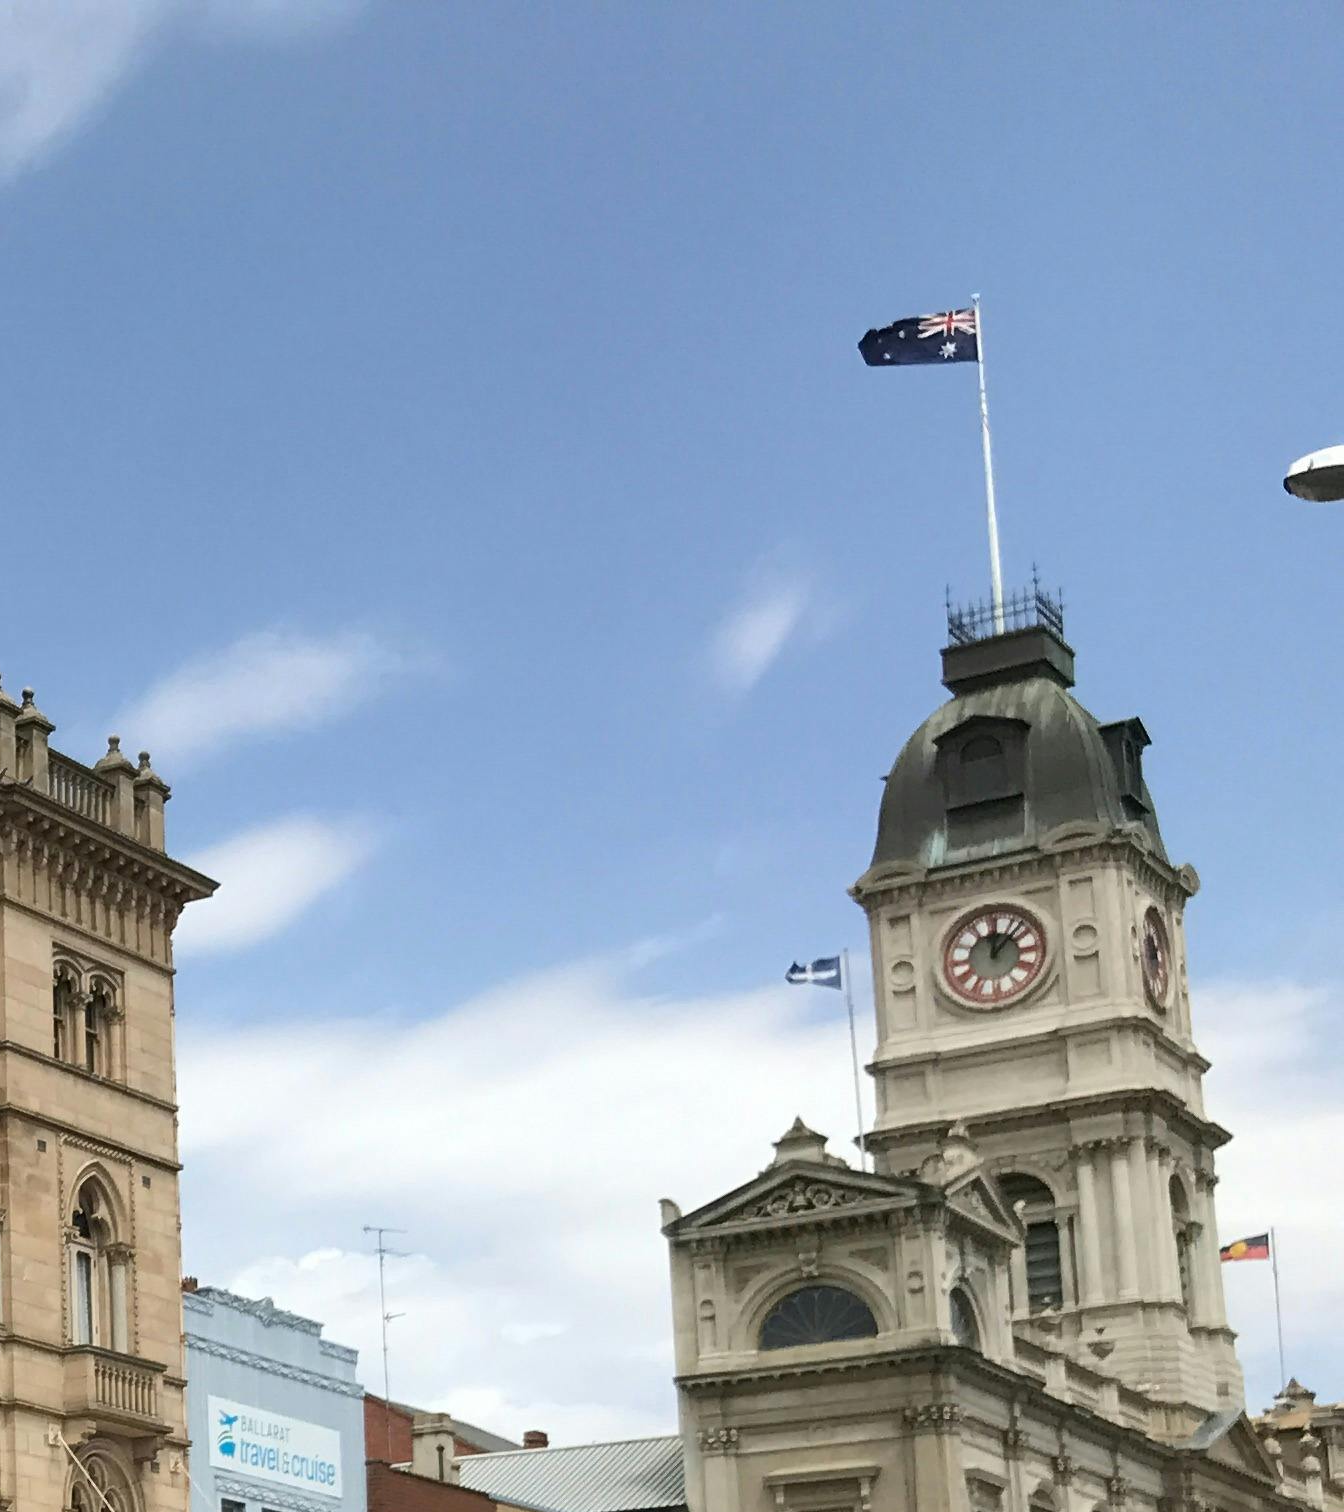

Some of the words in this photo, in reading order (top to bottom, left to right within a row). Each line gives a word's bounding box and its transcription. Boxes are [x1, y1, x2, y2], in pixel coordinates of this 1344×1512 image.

[241, 1415, 290, 1443] BALLARAT
[240, 1438, 279, 1472] travel
[281, 1451, 290, 1474] &
[291, 1453, 336, 1486] cruise
